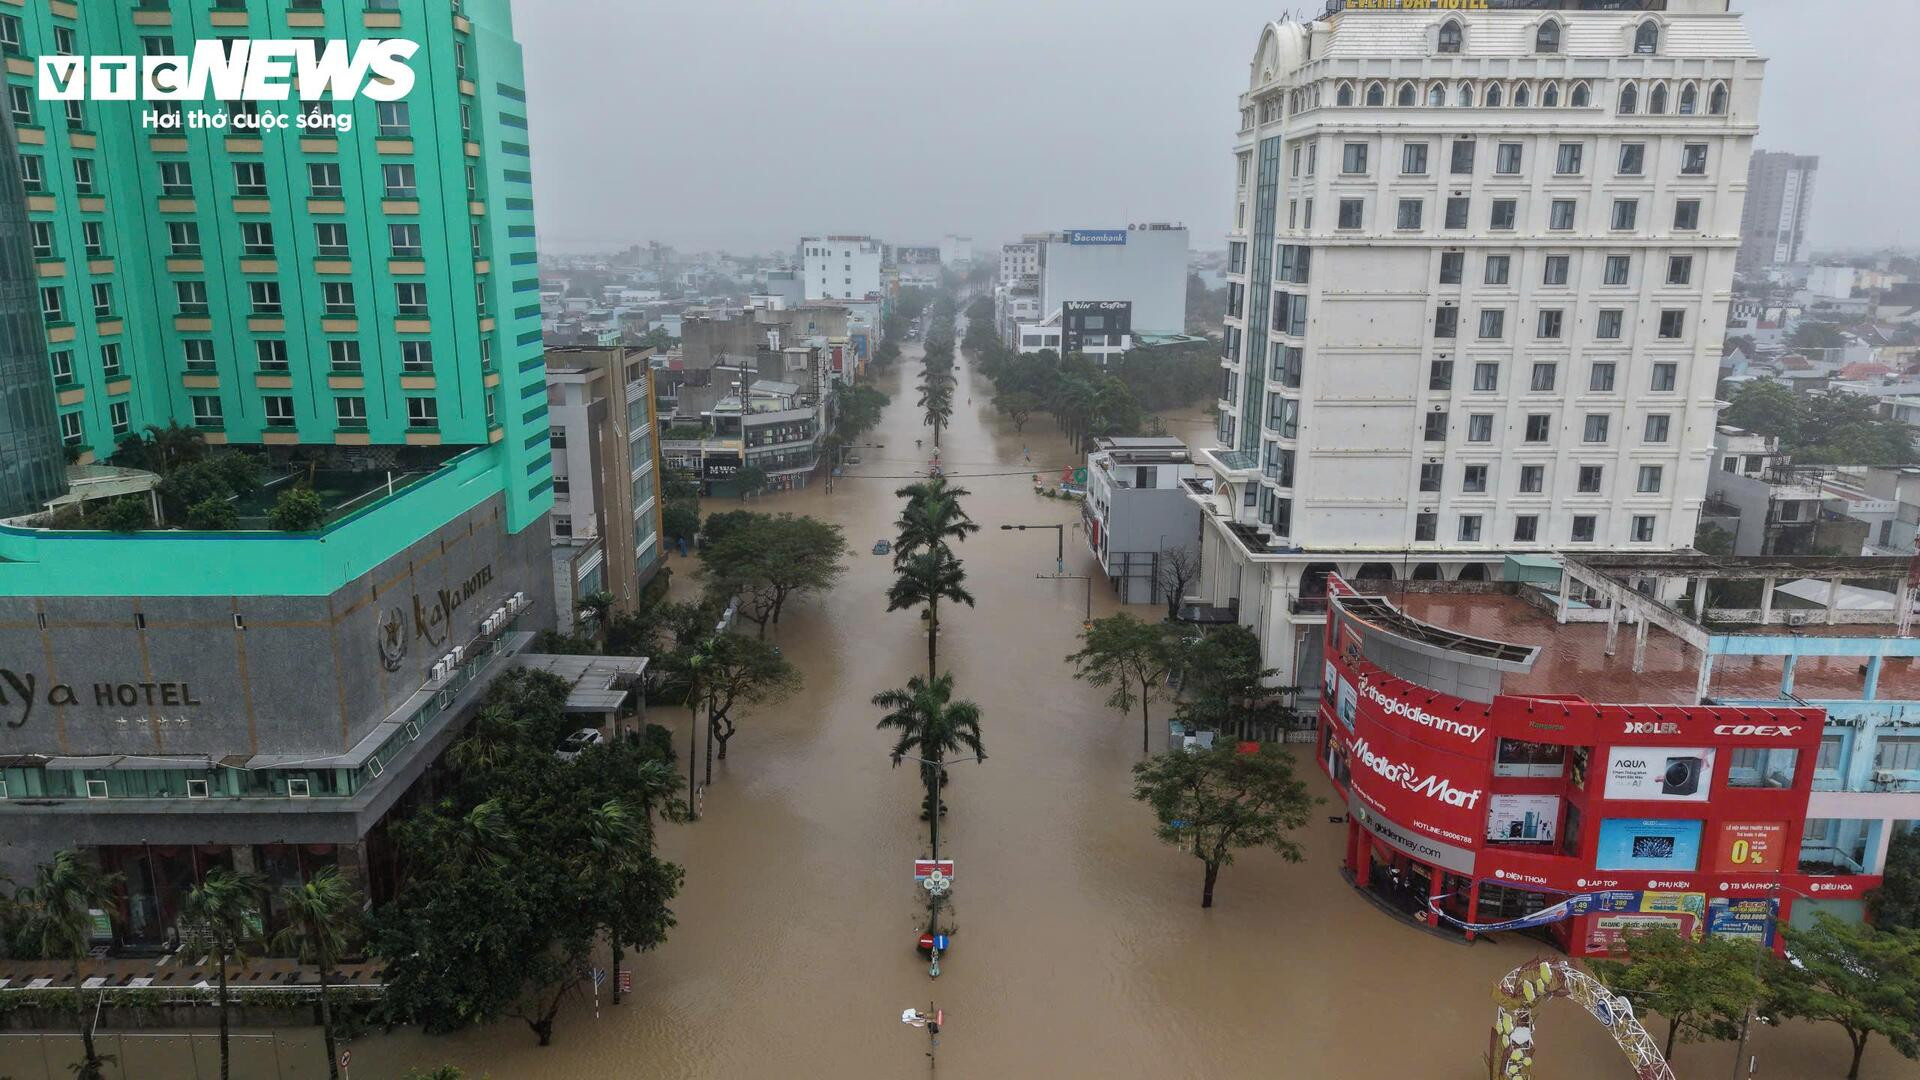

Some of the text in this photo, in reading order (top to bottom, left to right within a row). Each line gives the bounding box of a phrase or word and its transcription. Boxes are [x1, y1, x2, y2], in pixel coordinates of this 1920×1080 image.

[1073, 232, 1125, 242] Sacombank
[1099, 301, 1128, 309] Coffee
[463, 564, 494, 600] HOTEL
[0, 669, 200, 729] ya HOTEL
[1713, 724, 1802, 736] COEX
[1615, 760, 1646, 768] AQUA
[1413, 775, 1482, 810] Mart
[1658, 881, 1673, 889] PHỤ
